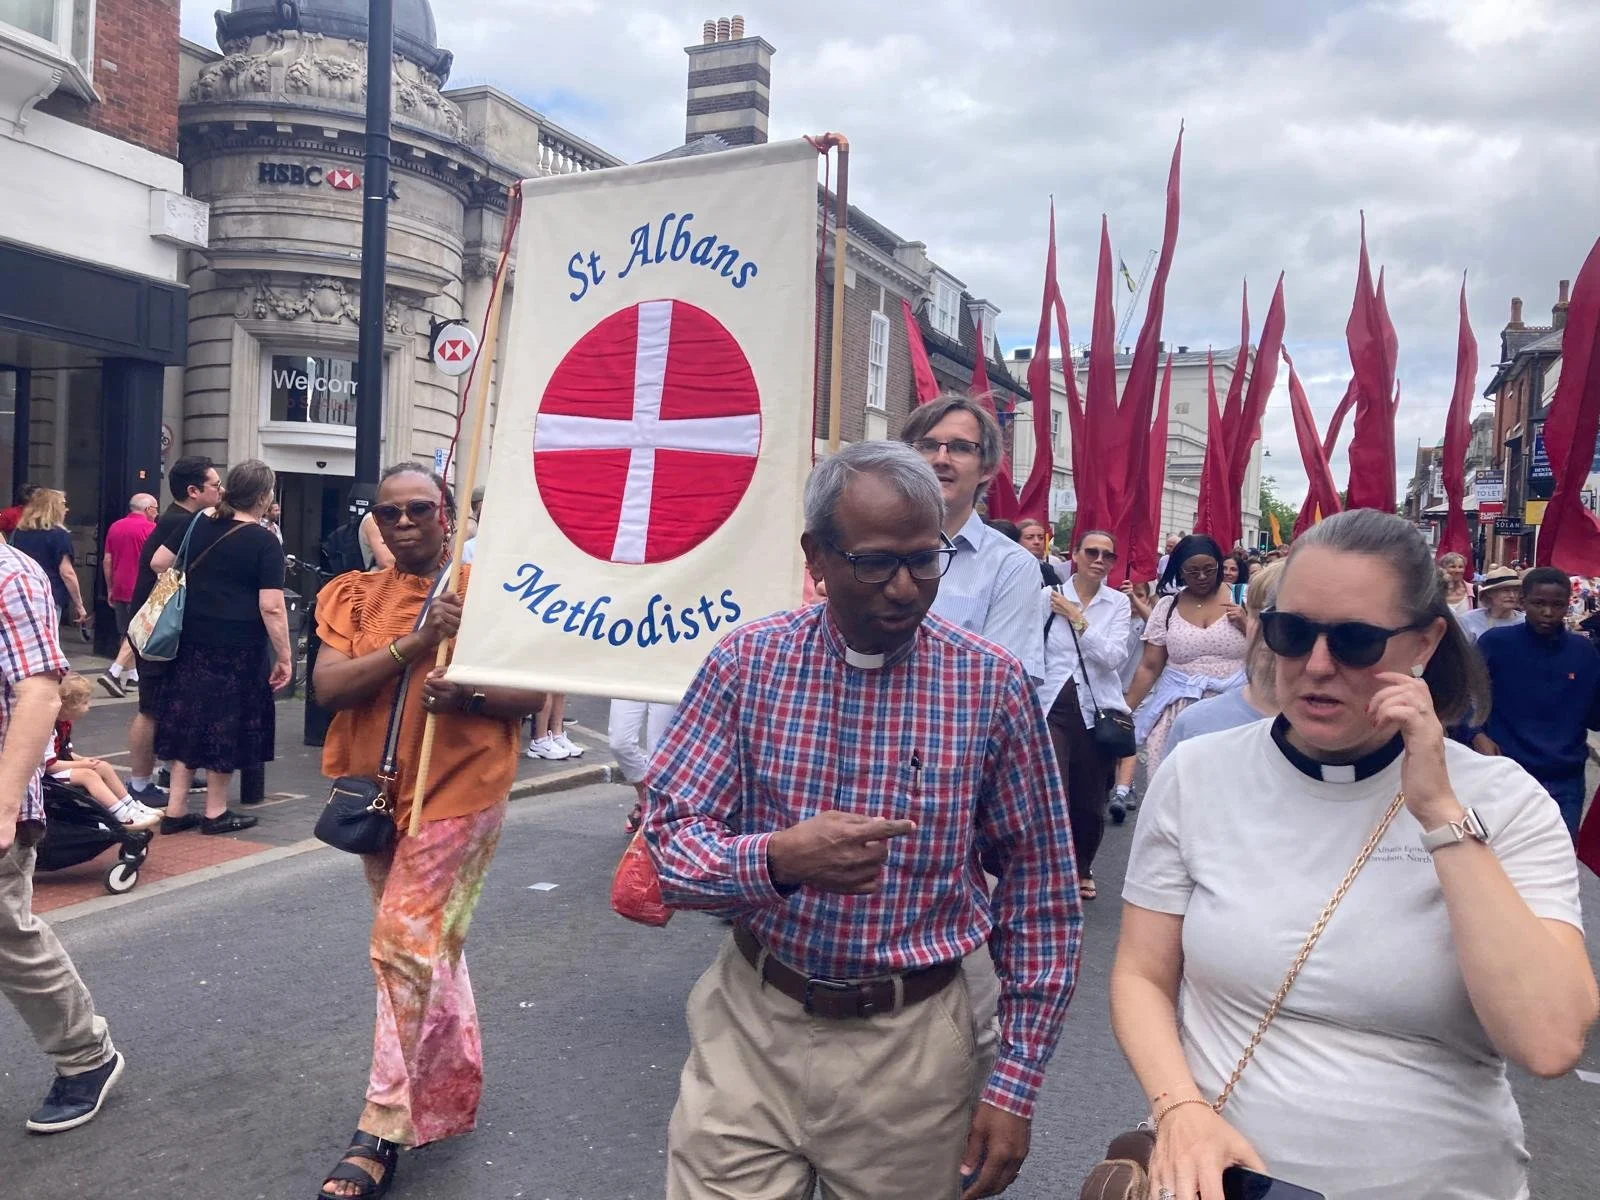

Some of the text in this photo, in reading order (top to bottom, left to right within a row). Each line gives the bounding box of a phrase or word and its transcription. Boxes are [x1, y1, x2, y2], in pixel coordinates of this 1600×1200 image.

[258, 162, 322, 186] HSBC
[567, 212, 758, 302] St Albans
[273, 369, 359, 395] Welcom
[503, 563, 741, 647] Methodists
